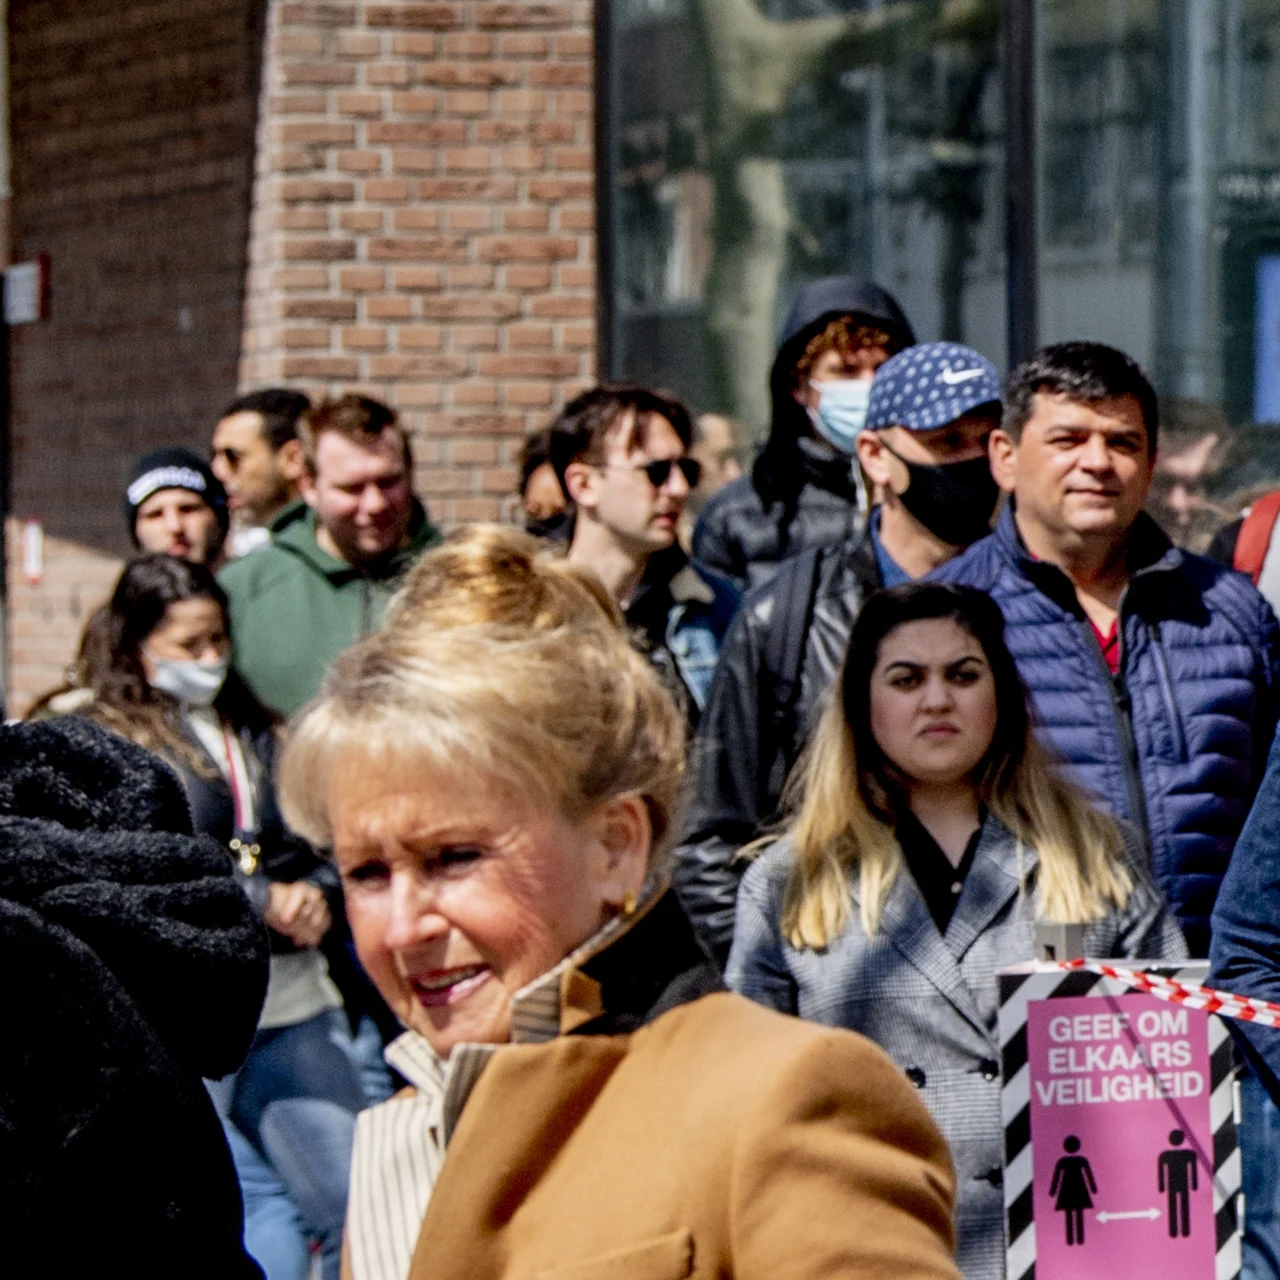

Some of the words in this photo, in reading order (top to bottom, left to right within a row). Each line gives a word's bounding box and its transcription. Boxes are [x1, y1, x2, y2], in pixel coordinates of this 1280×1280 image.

[1048, 1012, 1129, 1043] GEEF
[1137, 1009, 1188, 1038] OM
[1048, 1040, 1191, 1074] ELKAARS
[1035, 1070, 1204, 1106] VEILIGHEID
